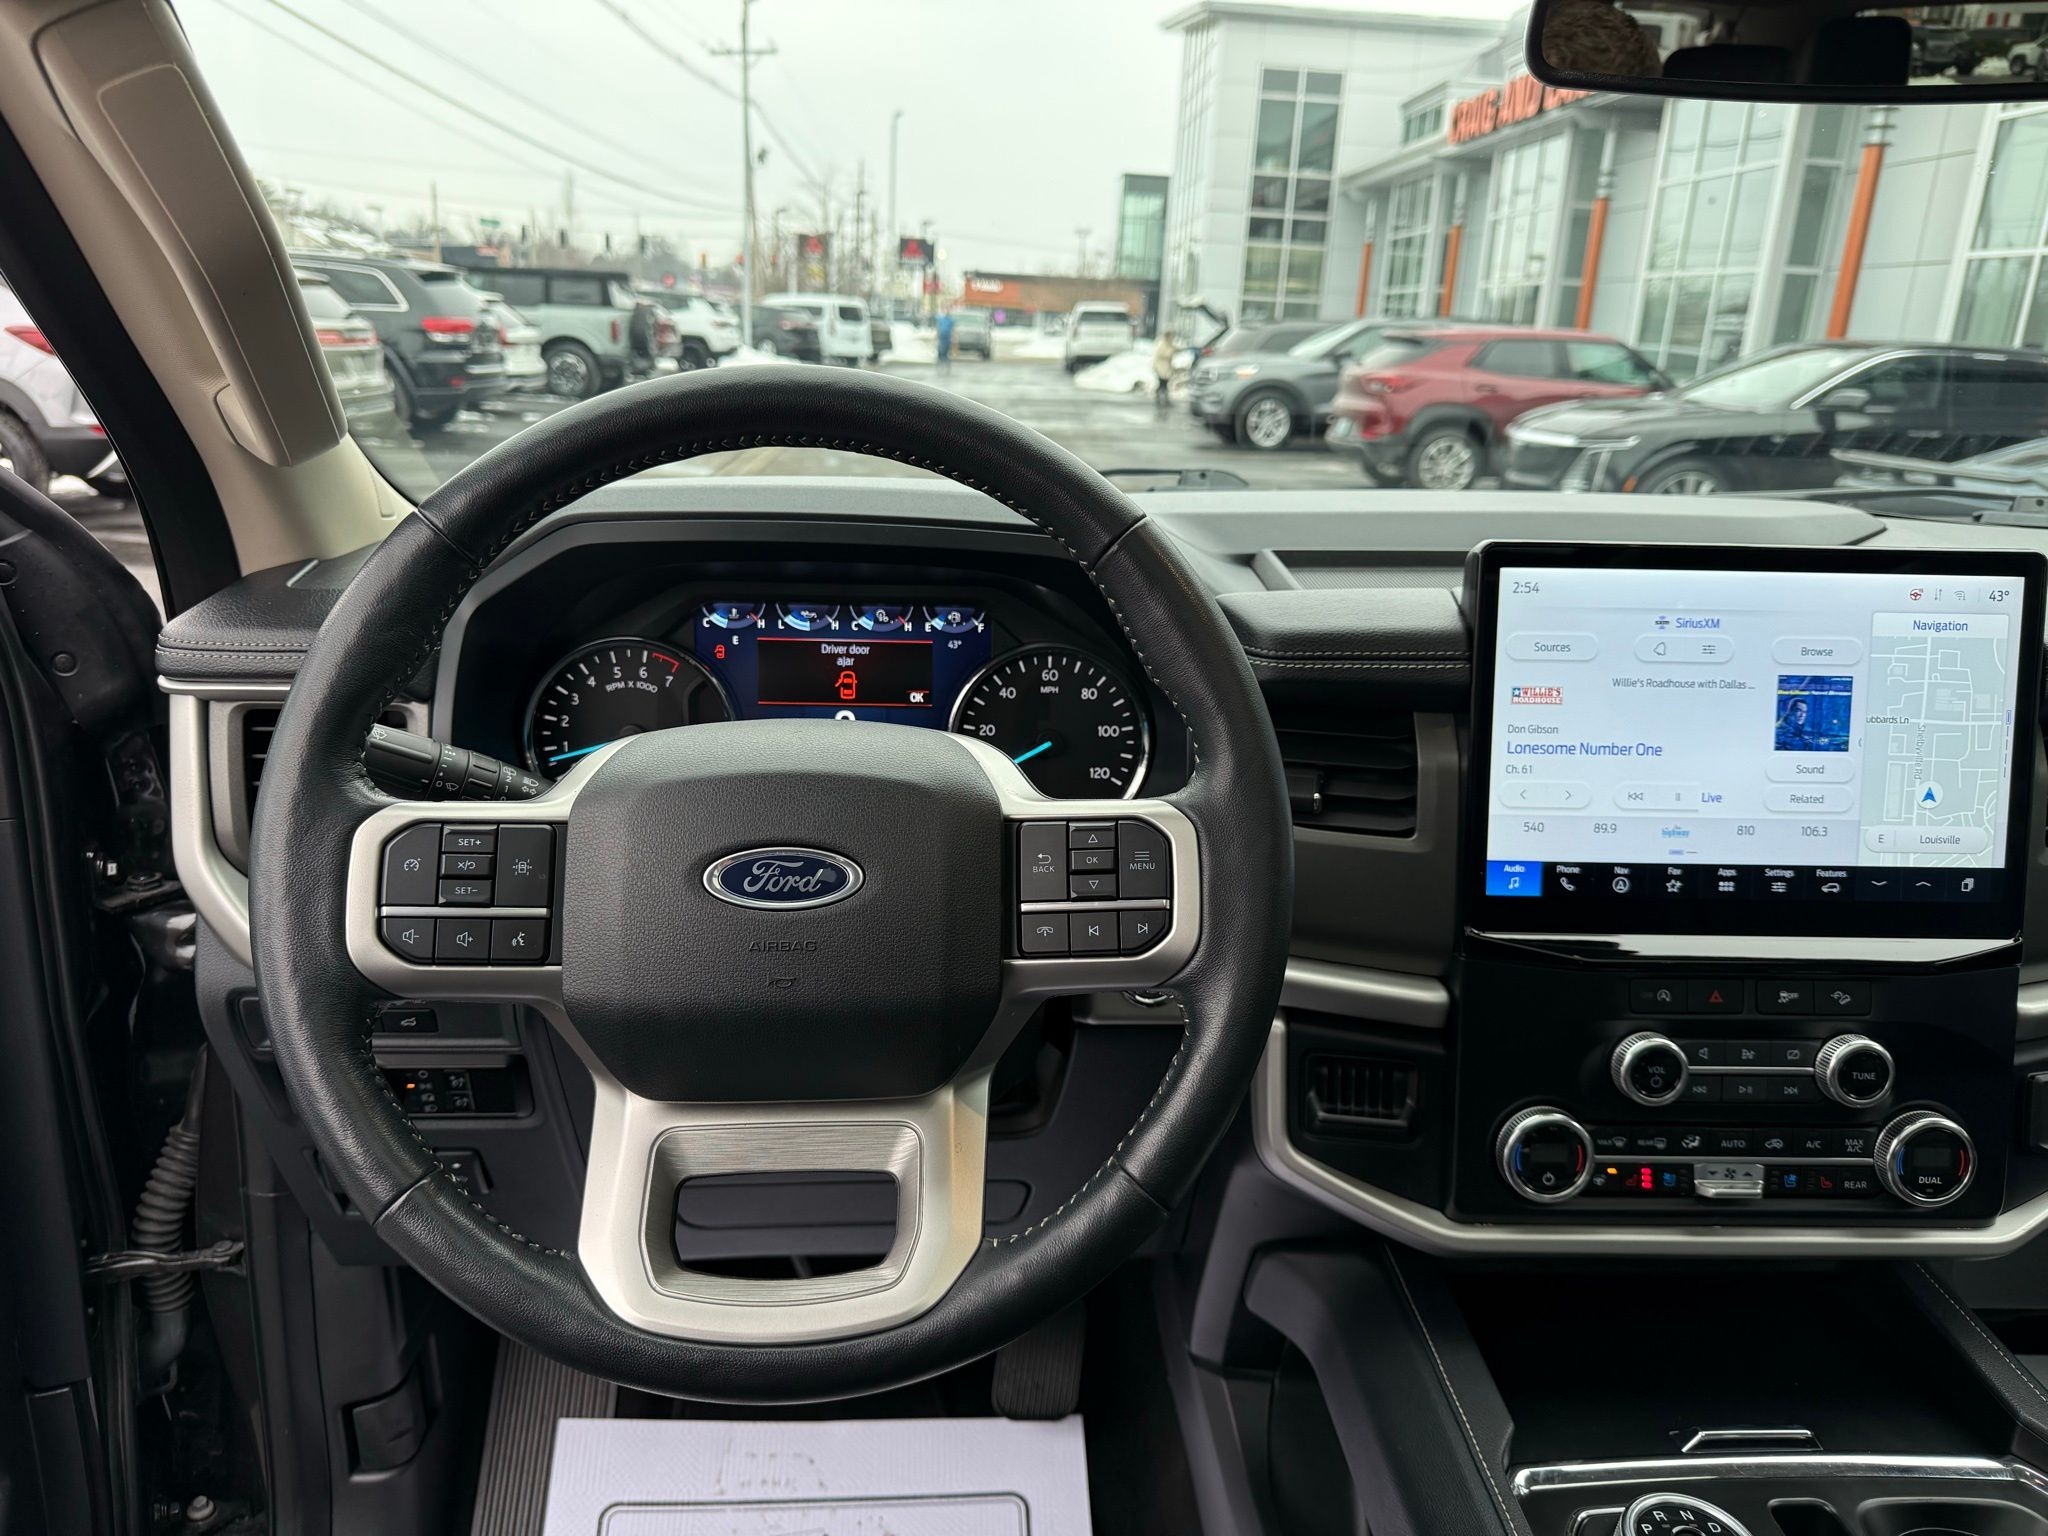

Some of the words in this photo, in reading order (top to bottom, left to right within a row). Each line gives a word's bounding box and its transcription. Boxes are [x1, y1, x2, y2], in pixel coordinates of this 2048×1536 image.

[1512, 582, 1540, 594] 2:54
[1989, 590, 2010, 602] 43°
[702, 618, 710, 628] C
[757, 619, 766, 629] H
[778, 620, 785, 629] L
[831, 621, 839, 630] H
[851, 621, 859, 631] C
[904, 622, 912, 632] H
[925, 622, 932, 632] E
[978, 623, 985, 633] F
[1675, 617, 1720, 629] SiriusXM
[1912, 620, 1969, 633] Navigation
[732, 635, 739, 645] E
[821, 644, 847, 654] Driver
[849, 644, 870, 655] door
[1533, 642, 1571, 653] Sources
[1800, 647, 1834, 657] Browse
[837, 657, 855, 667] ajar
[612, 666, 621, 678] 5
[639, 666, 648, 678] 6
[1042, 669, 1059, 681] 60
[587, 676, 596, 687] 4
[665, 675, 673, 687] 7
[1612, 678, 1645, 688] Willie's
[1645, 678, 1696, 689] Roadhouse
[1696, 679, 1718, 689] with
[1719, 680, 1747, 690] Dallas
[605, 681, 625, 693] RPM
[636, 681, 658, 693] 1000
[1040, 686, 1059, 694] MPH
[910, 692, 924, 703] OK
[999, 687, 1016, 699] 40
[1081, 688, 1098, 700] 80
[571, 693, 579, 705] 3
[560, 715, 569, 727] 2
[1899, 717, 1909, 725] Ln
[979, 724, 996, 736] 20
[1098, 725, 1120, 737] 100
[1507, 724, 1526, 734] Don
[1527, 724, 1559, 734] Gibson
[563, 741, 568, 751] 1
[1506, 741, 1576, 755] Lonesome
[1579, 742, 1633, 756] Number
[1635, 743, 1663, 756] One
[1914, 724, 1926, 766] Shelbyville
[1089, 767, 1110, 779] 120
[1505, 764, 1520, 774] Ch.
[1521, 765, 1533, 774] 61
[1796, 765, 1825, 775] Sound
[1914, 768, 1923, 780] Rd
[505, 775, 512, 783] 2
[1701, 792, 1723, 803] Live
[1790, 794, 1825, 804] Related
[1523, 822, 1545, 832] 540
[1593, 823, 1618, 834] 89.9
[1736, 826, 1755, 836] 810
[1801, 826, 1828, 837] 106.3
[1878, 835, 1884, 843] E
[1919, 834, 1961, 845] Louisville
[1086, 856, 1099, 864] OK
[1032, 865, 1055, 873] BACK
[1129, 862, 1156, 870] MENU
[1503, 865, 1526, 873] Audio
[1556, 865, 1582, 874] Phone
[1614, 866, 1630, 875] Nav
[743, 859, 825, 893] Ford
[1717, 868, 1738, 877] Apps
[1764, 868, 1795, 878] Settings
[1816, 869, 1847, 878] Features
[749, 940, 817, 951] AIRBAG
[1648, 1065, 1666, 1075] VOL
[1852, 1072, 1876, 1081] TUNE
[1721, 1140, 1746, 1148] AUTO
[1806, 1140, 1822, 1149] A/C
[1847, 1145, 1862, 1153] A/C
[1918, 1176, 1942, 1184] DUAL
[1844, 1181, 1867, 1190] REAR
[1652, 1510, 1668, 1522] R
[1679, 1510, 1695, 1521] N
[1641, 1523, 1653, 1535] P
[1707, 1522, 1722, 1533] D
